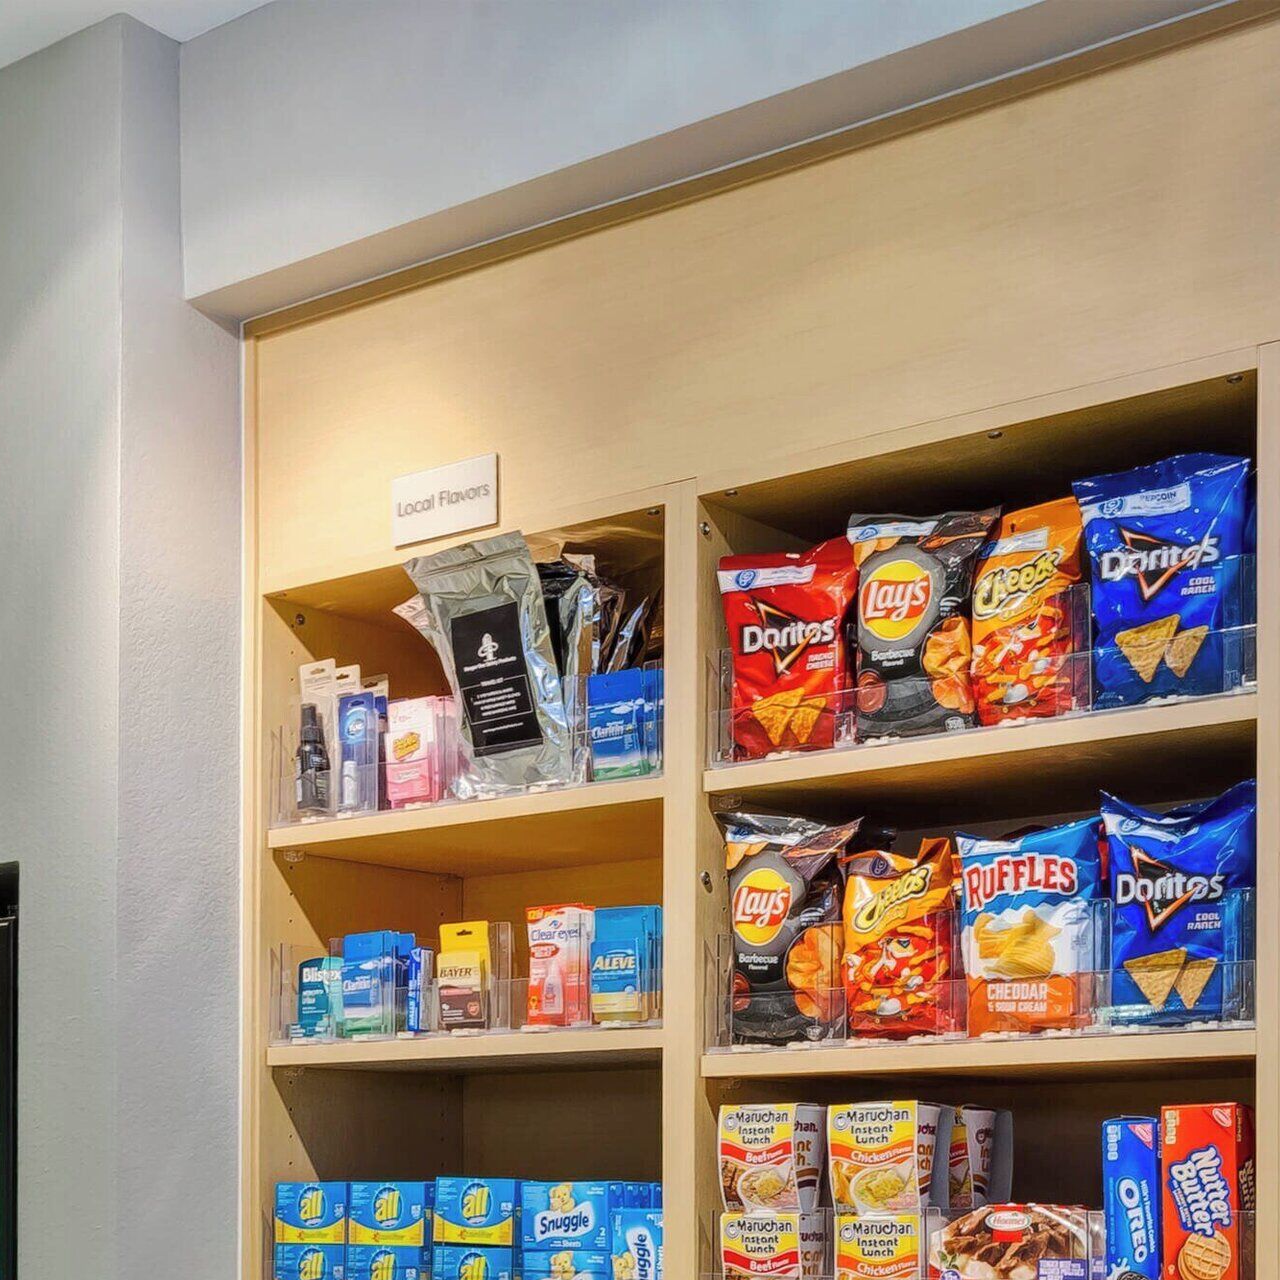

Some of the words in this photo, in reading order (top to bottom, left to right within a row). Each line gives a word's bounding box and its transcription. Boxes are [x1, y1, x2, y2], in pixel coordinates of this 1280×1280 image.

[396, 493, 435, 518] Local
[438, 483, 491, 508] Flavors
[1100, 537, 1220, 581] Doritos
[864, 578, 929, 623] Lay's
[742, 617, 835, 654] Doritos
[964, 853, 1079, 912] RUFFLES
[1116, 873, 1226, 905] Doritos
[735, 885, 791, 928] Lay's
[1195, 912, 1221, 922] COOL
[1186, 920, 1222, 931] RANCH
[530, 929, 556, 942] Clear
[592, 955, 637, 971] ALEVE
[738, 952, 779, 965] Barbecue
[302, 966, 342, 984] Blistex
[439, 966, 473, 979] BAYER
[986, 983, 1049, 1001] CHEDDAR
[736, 1108, 789, 1124] Maruchan
[846, 1107, 909, 1122] Maruchan
[738, 1124, 775, 1135] Instant
[850, 1123, 893, 1134] Instant
[741, 1134, 771, 1145] Lunch
[855, 1133, 889, 1144] Lunch
[745, 1150, 768, 1163] Beef
[851, 1148, 894, 1162] Chicken
[1190, 1146, 1232, 1227] Nutter
[299, 1189, 324, 1221] all
[374, 1190, 400, 1221] all
[461, 1186, 489, 1219] all
[1170, 1161, 1215, 1237] Butter
[539, 1212, 590, 1236] Snuggle
[736, 1219, 793, 1233] Maruchan
[1118, 1177, 1148, 1264] OREO
[852, 1221, 914, 1235] Maruchan
[740, 1234, 779, 1244] Instant
[857, 1236, 899, 1247] Instant
[744, 1243, 776, 1253] Lunch
[861, 1246, 895, 1257] Lunch
[749, 1258, 773, 1272] Beef
[857, 1262, 898, 1276] Chicken
